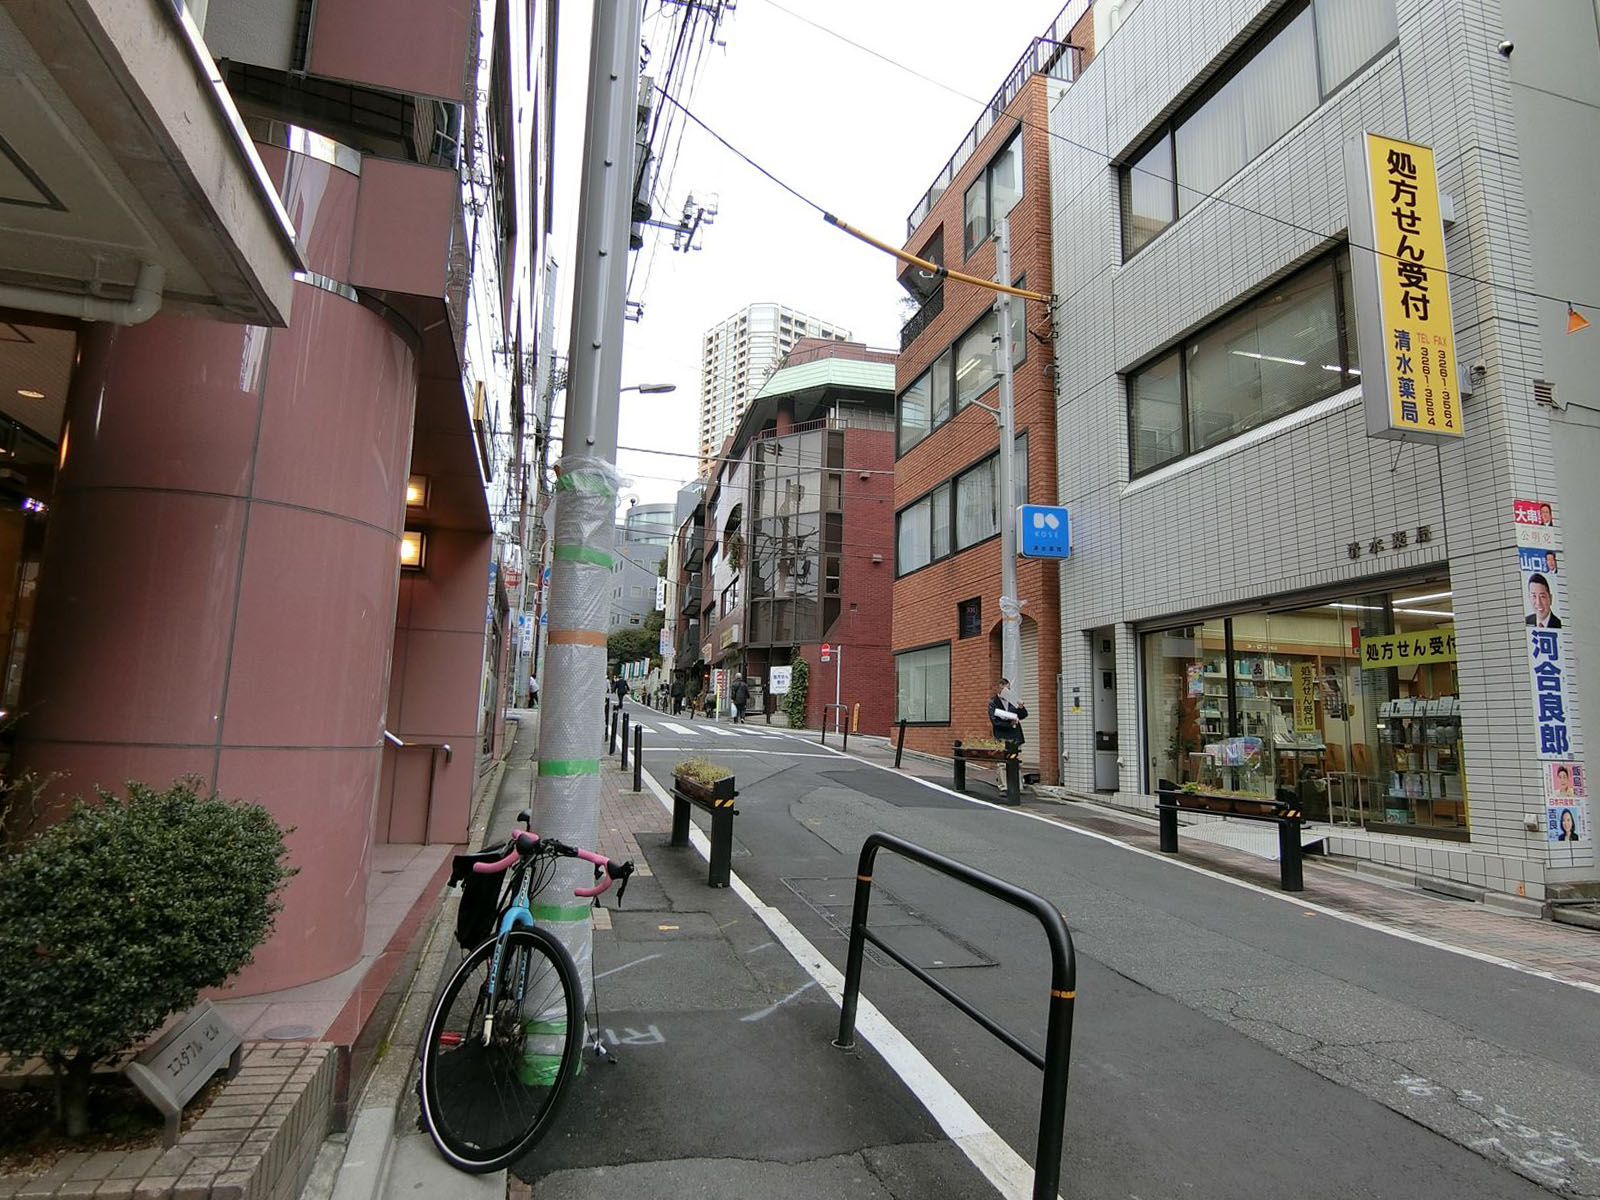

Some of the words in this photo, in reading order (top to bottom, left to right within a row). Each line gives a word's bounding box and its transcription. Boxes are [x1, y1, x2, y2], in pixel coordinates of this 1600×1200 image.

[1387, 149, 1429, 321] 処方せん受付
[1417, 332, 1430, 345] TEL
[1433, 335, 1448, 346] FAX
[1394, 329, 1418, 424] 清水薬局
[1520, 556, 1542, 572] 山口
[1301, 666, 1314, 726] 処方せん受付
[1531, 630, 1568, 754] 河合良郎
